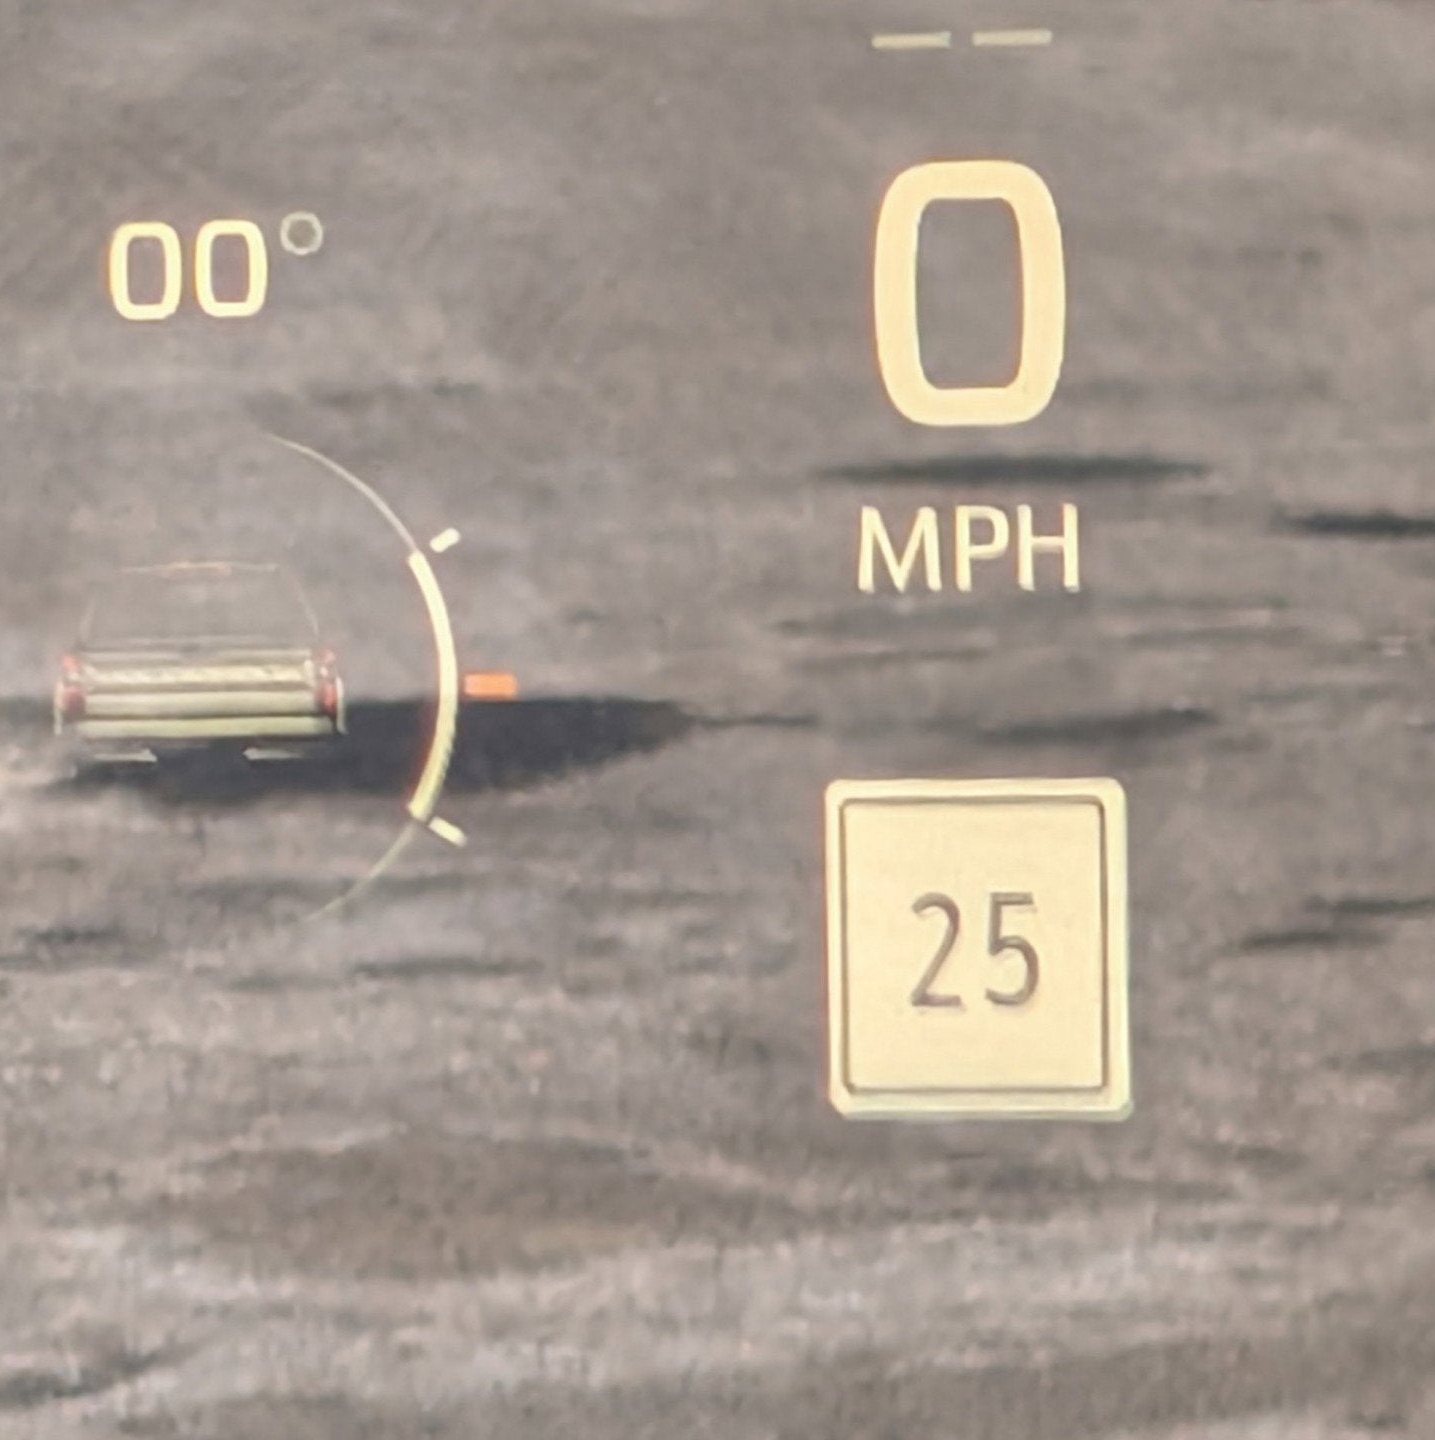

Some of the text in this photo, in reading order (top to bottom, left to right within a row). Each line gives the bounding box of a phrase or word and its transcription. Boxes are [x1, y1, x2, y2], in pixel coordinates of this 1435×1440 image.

[873, 160, 1066, 426] 0
[857, 503, 1080, 593] MPH
[911, 892, 1040, 1007] 25
